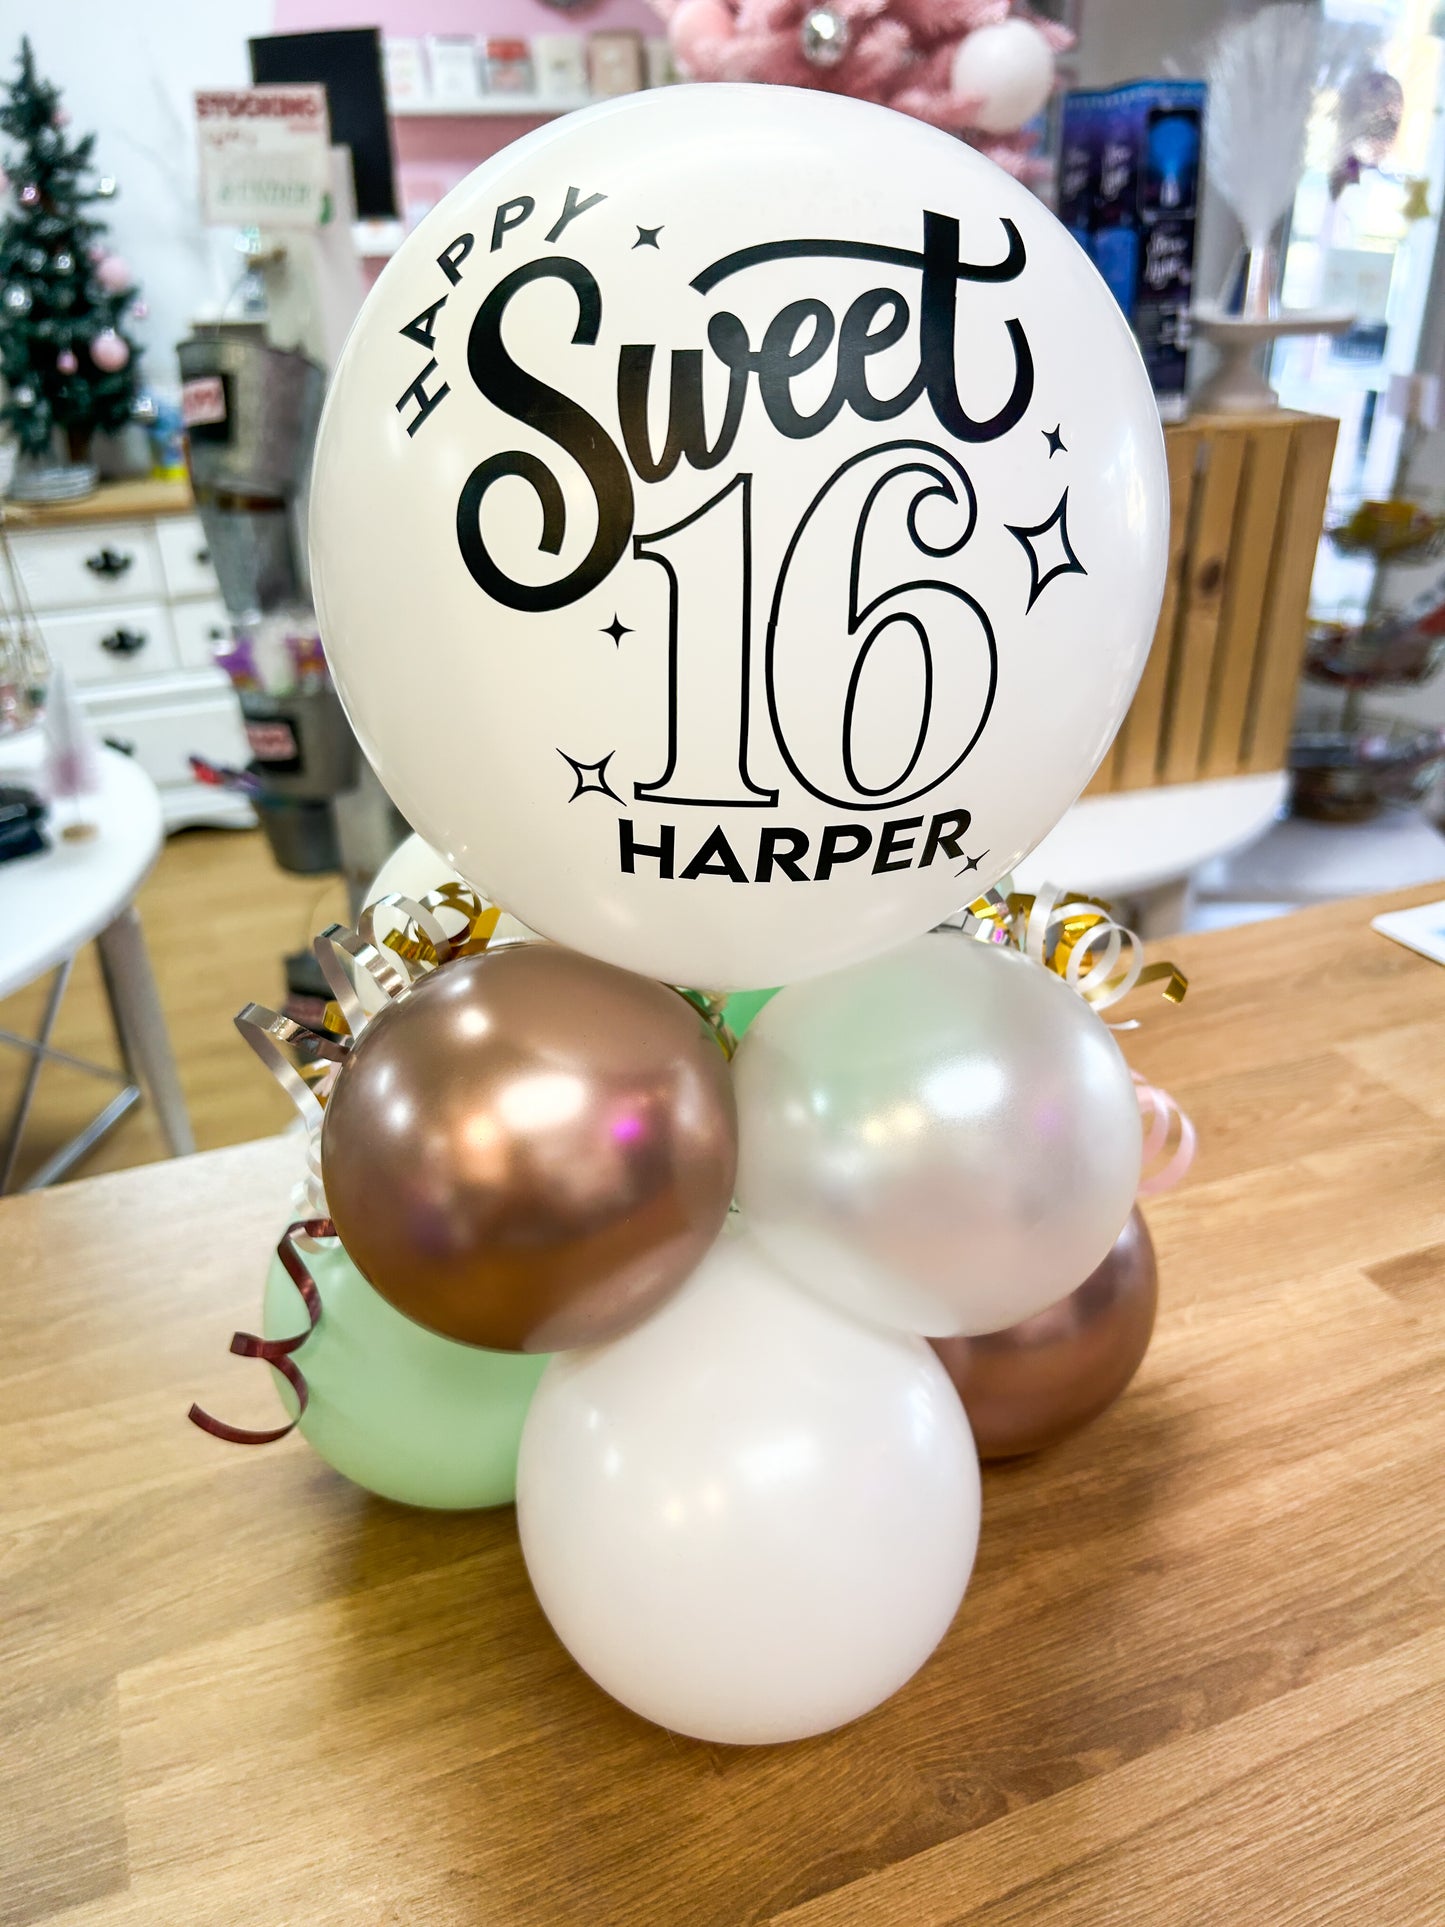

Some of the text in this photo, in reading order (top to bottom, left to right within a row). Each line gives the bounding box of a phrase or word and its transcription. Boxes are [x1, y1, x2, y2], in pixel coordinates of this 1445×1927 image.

[395, 186, 608, 438] HAPPY
[456, 209, 1034, 613] Sweet
[633, 438, 998, 812] 16
[618, 808, 972, 883] HARPER
